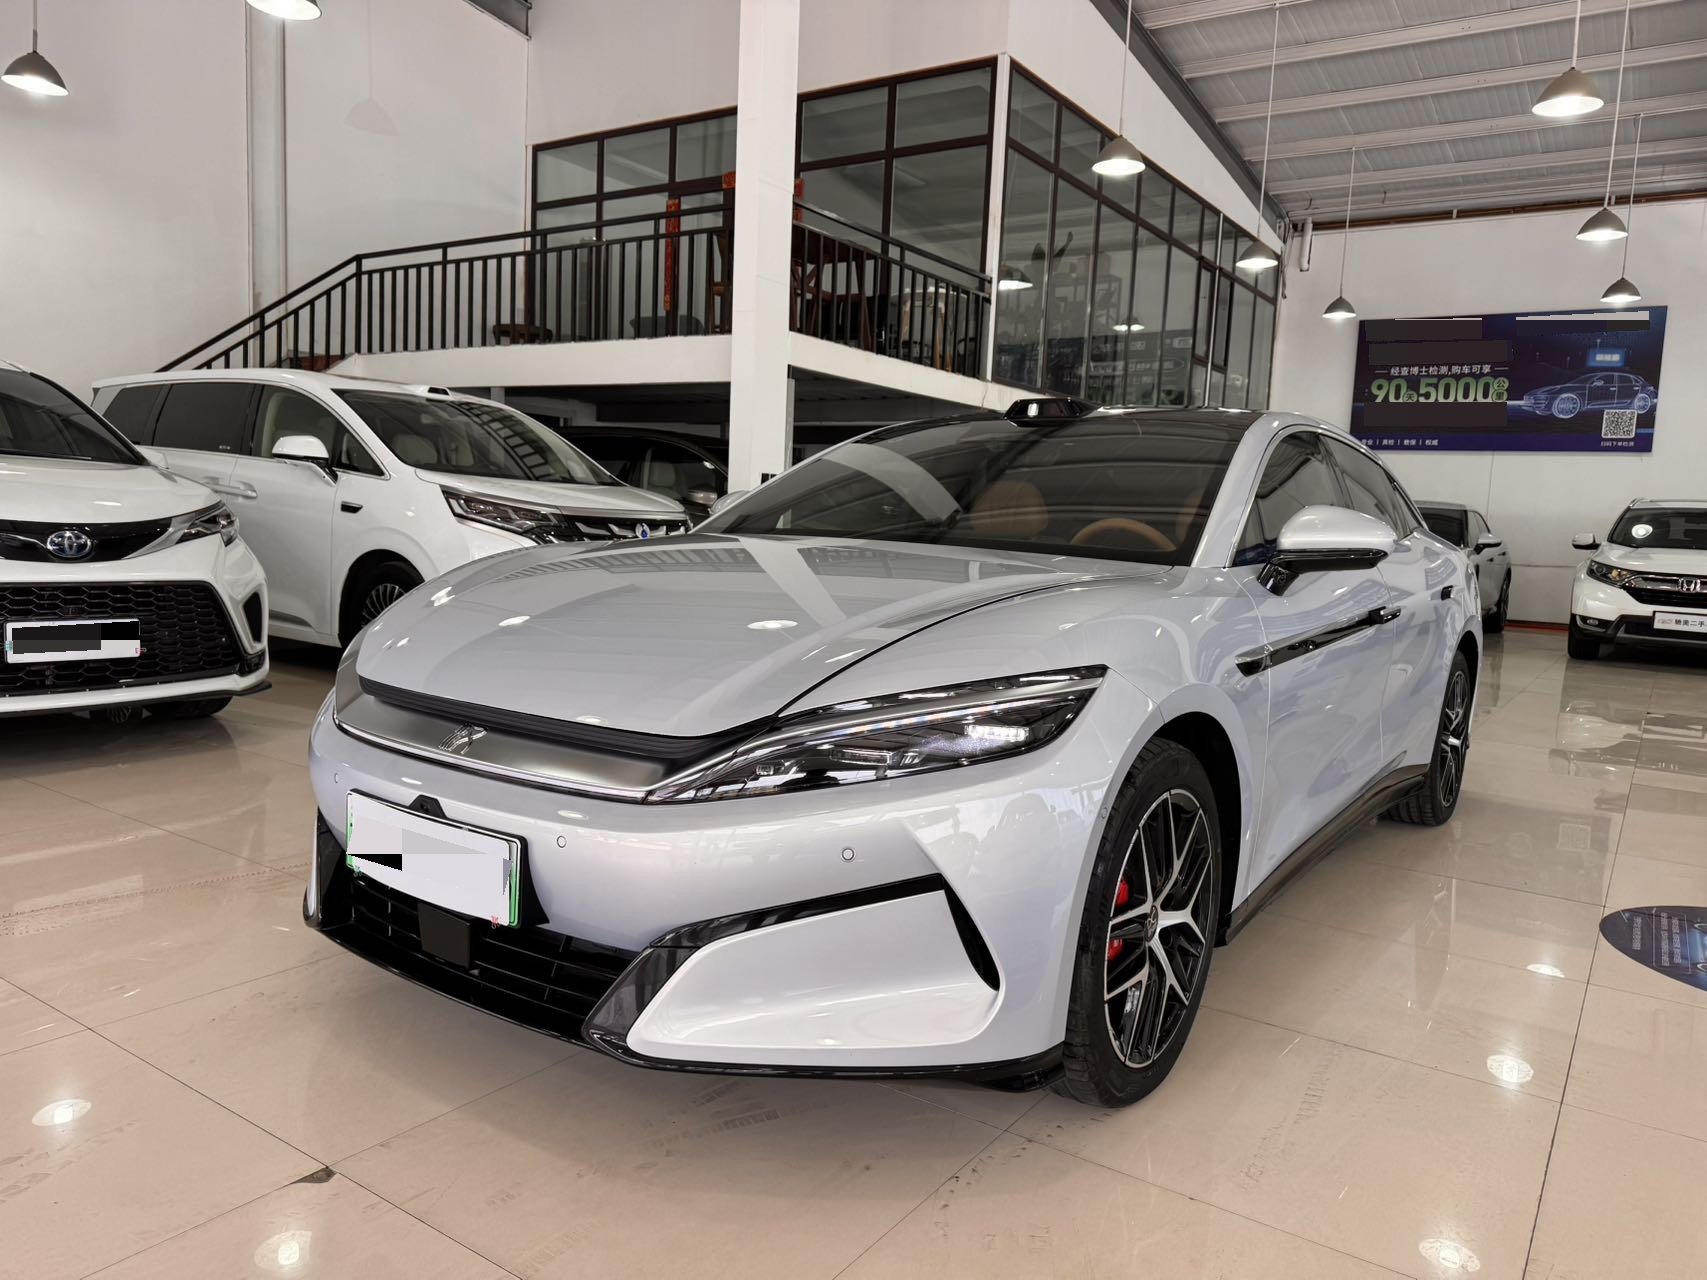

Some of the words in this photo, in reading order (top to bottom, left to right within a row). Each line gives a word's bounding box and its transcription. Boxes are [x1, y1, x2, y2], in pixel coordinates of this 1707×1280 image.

[1390, 365, 1492, 376] 经查博士检测,购车可享
